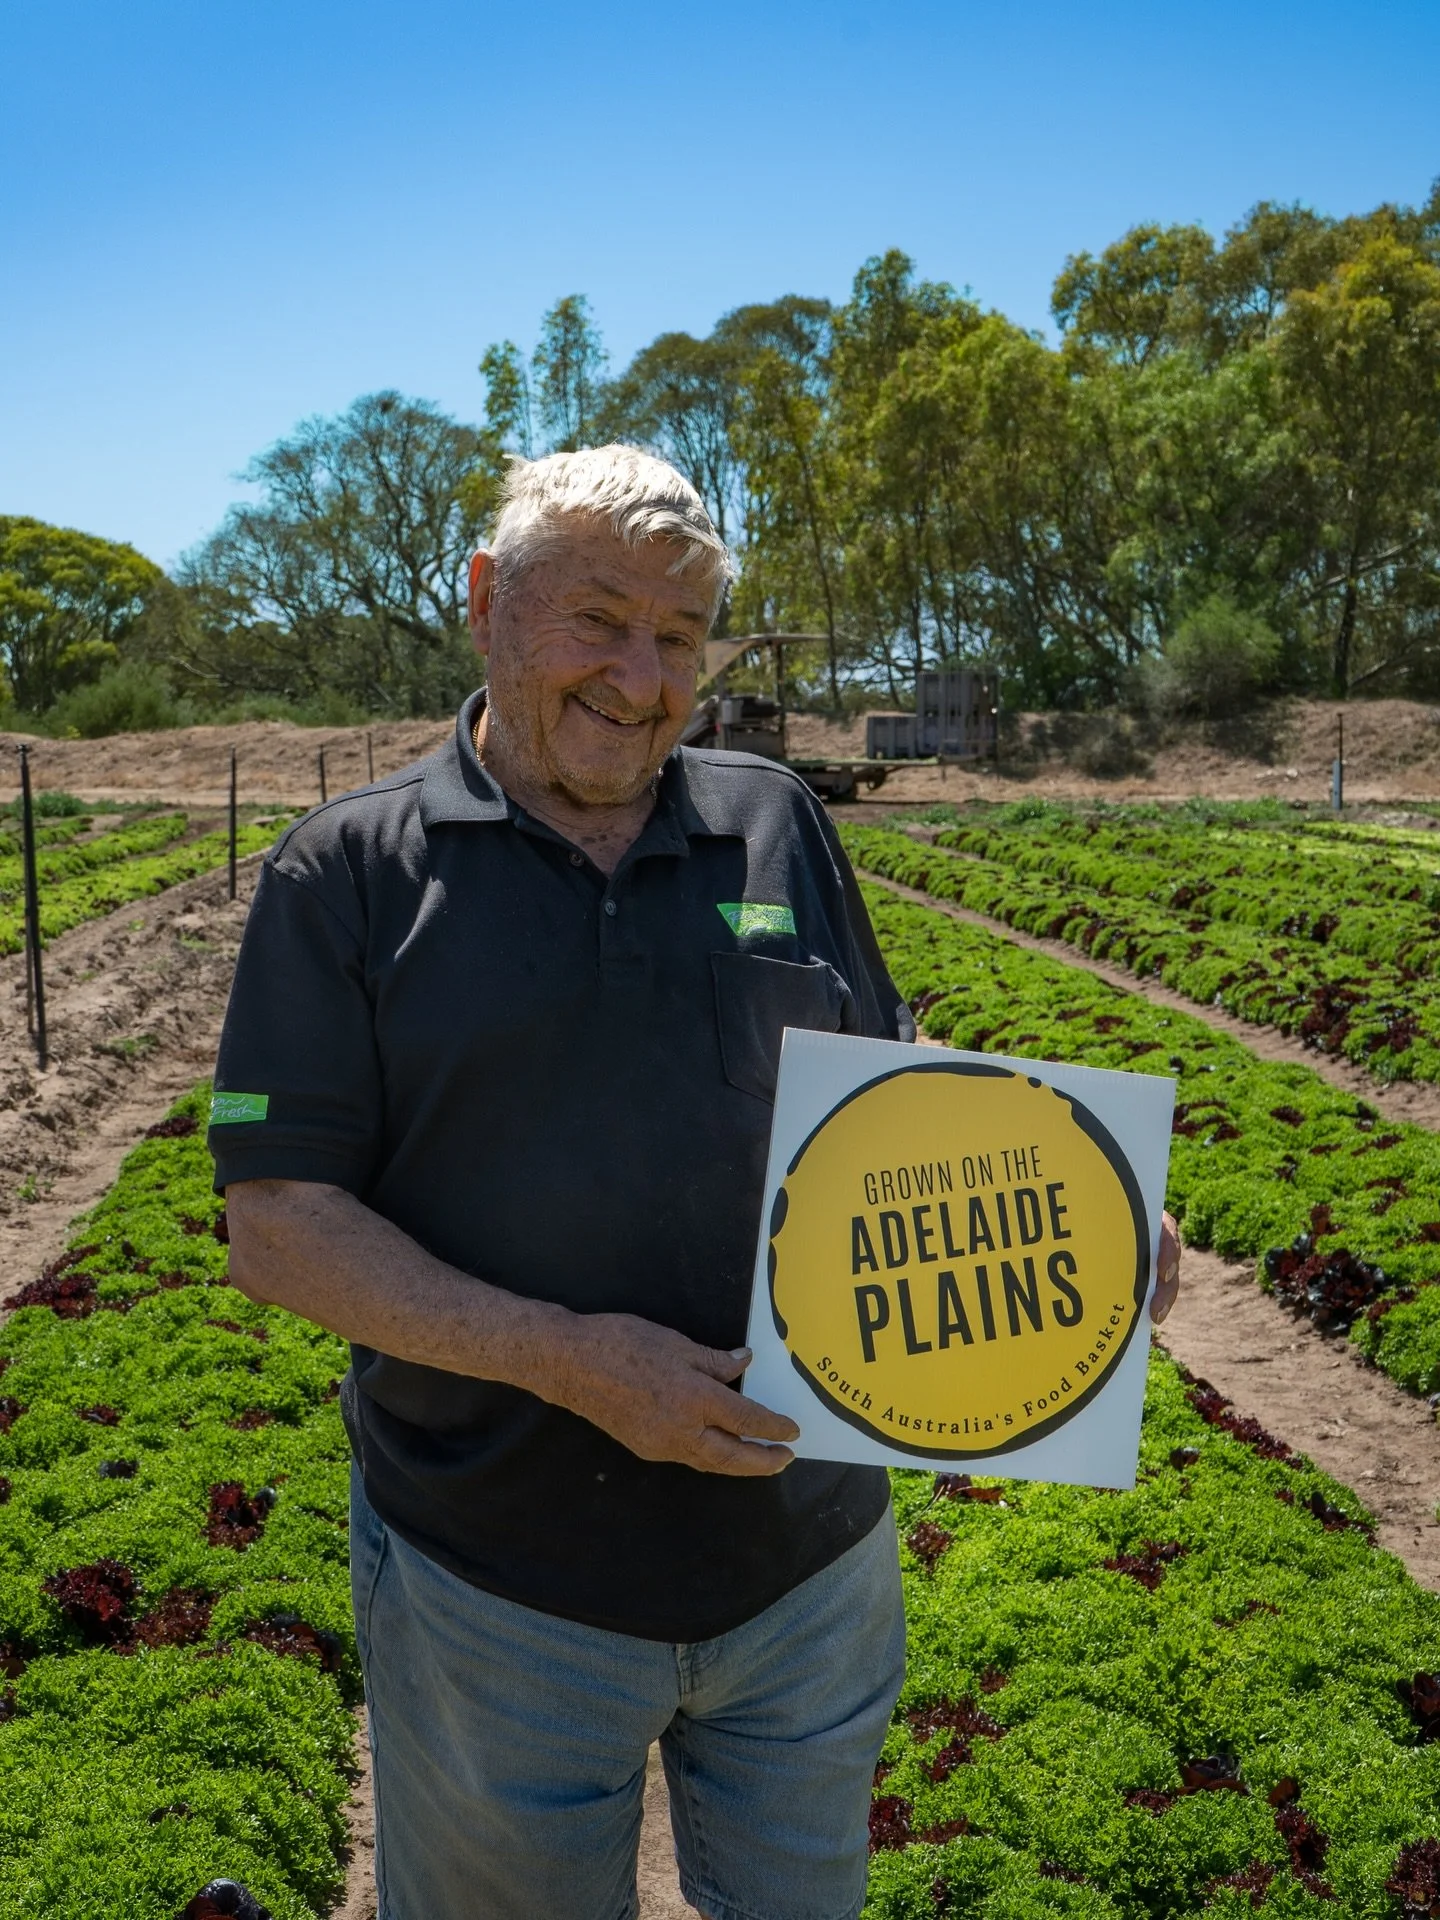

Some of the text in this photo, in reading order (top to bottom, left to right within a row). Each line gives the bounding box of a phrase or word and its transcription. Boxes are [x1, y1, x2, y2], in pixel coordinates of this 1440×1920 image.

[864, 1146, 1042, 1205] GROWN ON THE
[852, 1182, 1072, 1275] ADELAIDE
[854, 1251, 1083, 1363] PLAINS
[817, 1304, 1124, 1434] South Australia's Food Basket
